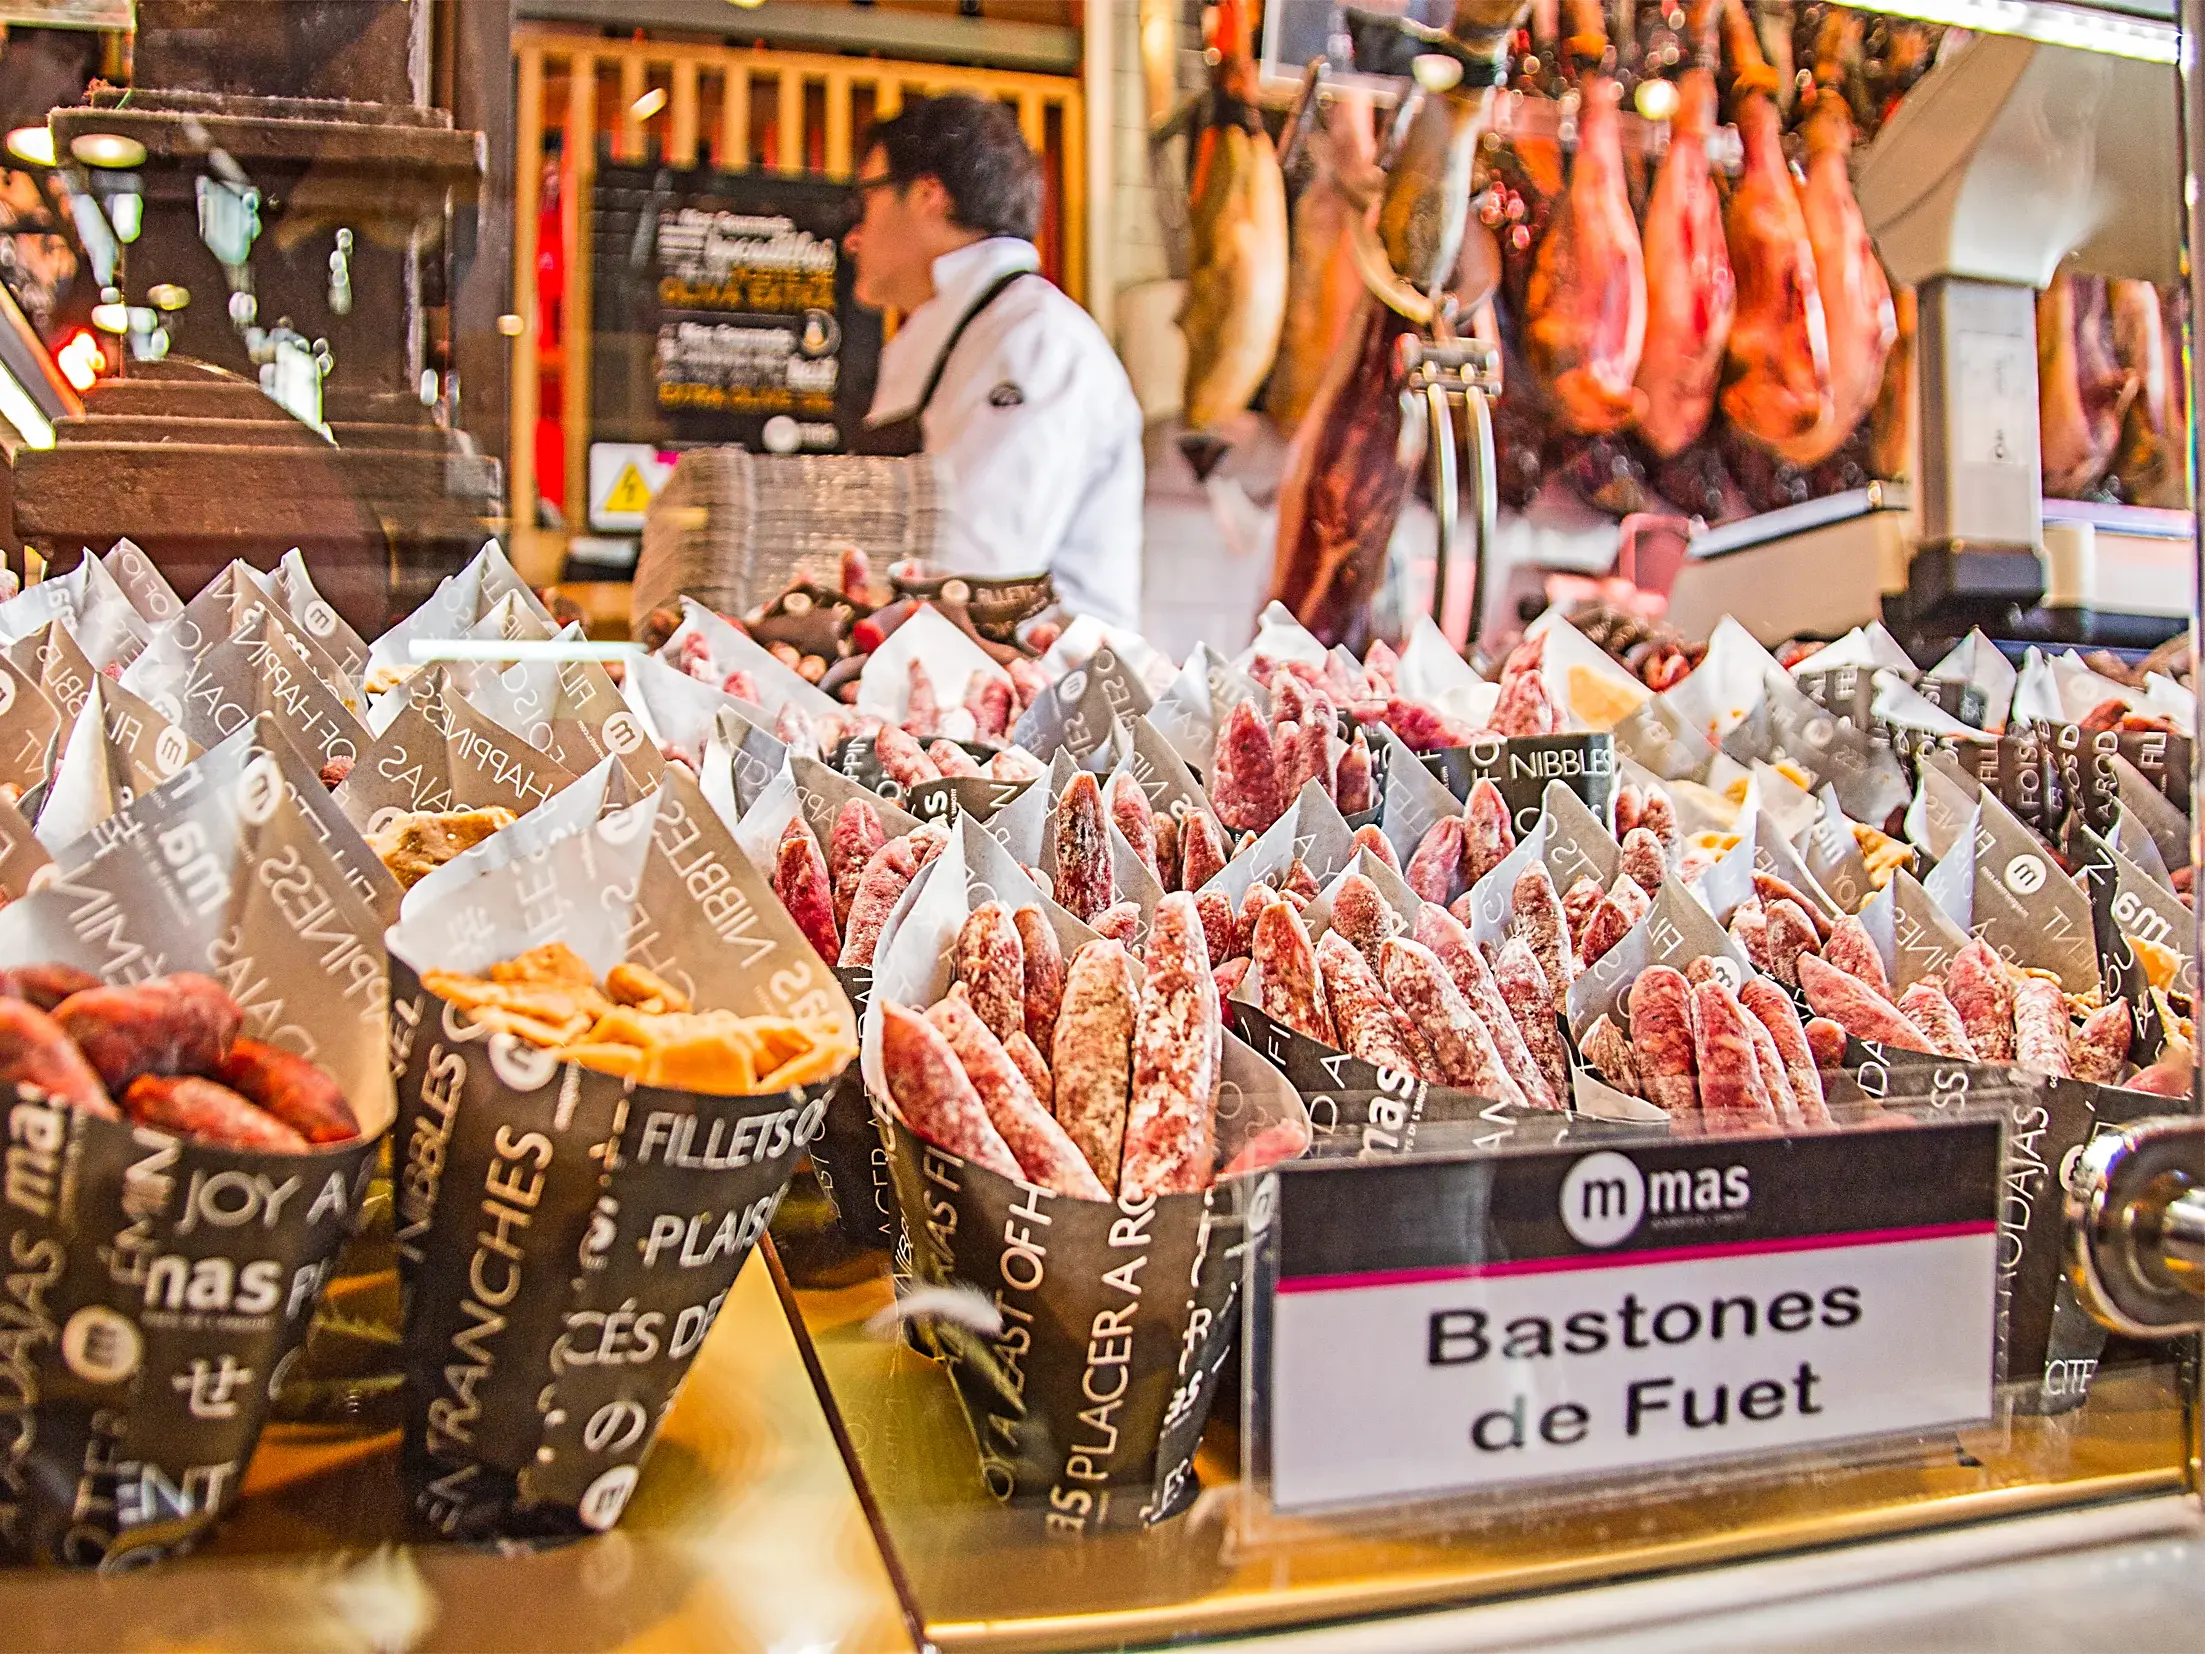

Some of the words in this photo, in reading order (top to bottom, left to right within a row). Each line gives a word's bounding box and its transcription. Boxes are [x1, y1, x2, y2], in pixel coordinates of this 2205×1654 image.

[1511, 747, 1613, 781] NIBBLES
[638, 1109, 798, 1170] FILLETS
[174, 1168, 301, 1236] JOY
[306, 1169, 348, 1226] A
[1650, 1164, 1750, 1213] mas
[427, 1125, 554, 1453] TRANCHES
[1000, 1212, 1048, 1292] OF
[1427, 1284, 1864, 1367] Bastones
[1065, 1302, 1139, 1482] PLACER
[1102, 1255, 1148, 1298] A
[1472, 1393, 1590, 1453] de
[1625, 1360, 1824, 1438] Fuet
